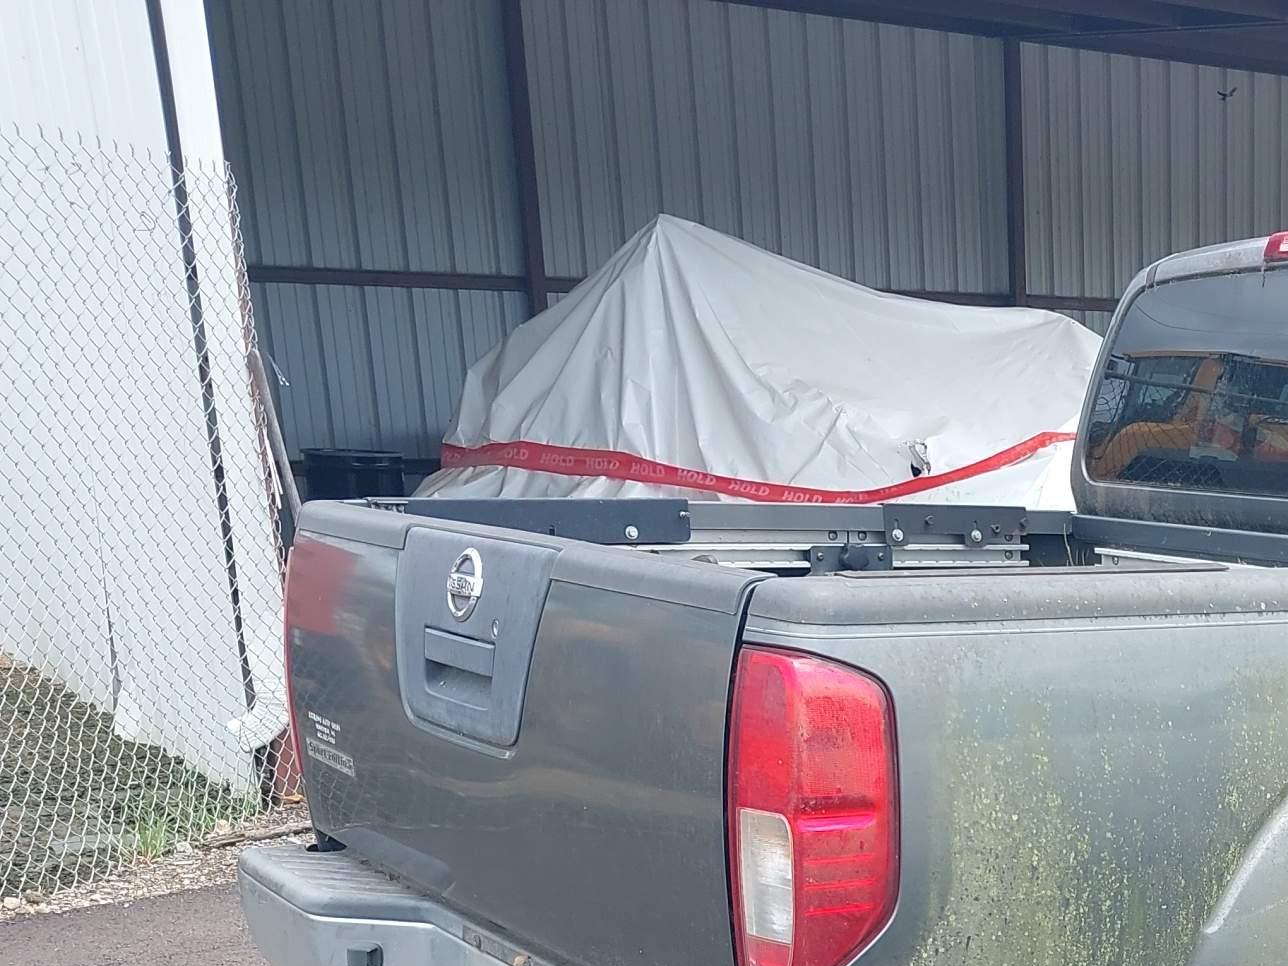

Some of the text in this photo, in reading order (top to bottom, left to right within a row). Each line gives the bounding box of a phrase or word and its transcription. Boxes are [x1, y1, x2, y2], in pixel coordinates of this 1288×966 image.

[539, 453, 575, 467] HOLD
[585, 457, 620, 471] HOLD
[630, 462, 664, 478] HOLD
[676, 469, 717, 486] HOLD
[728, 479, 770, 497] HOLD
